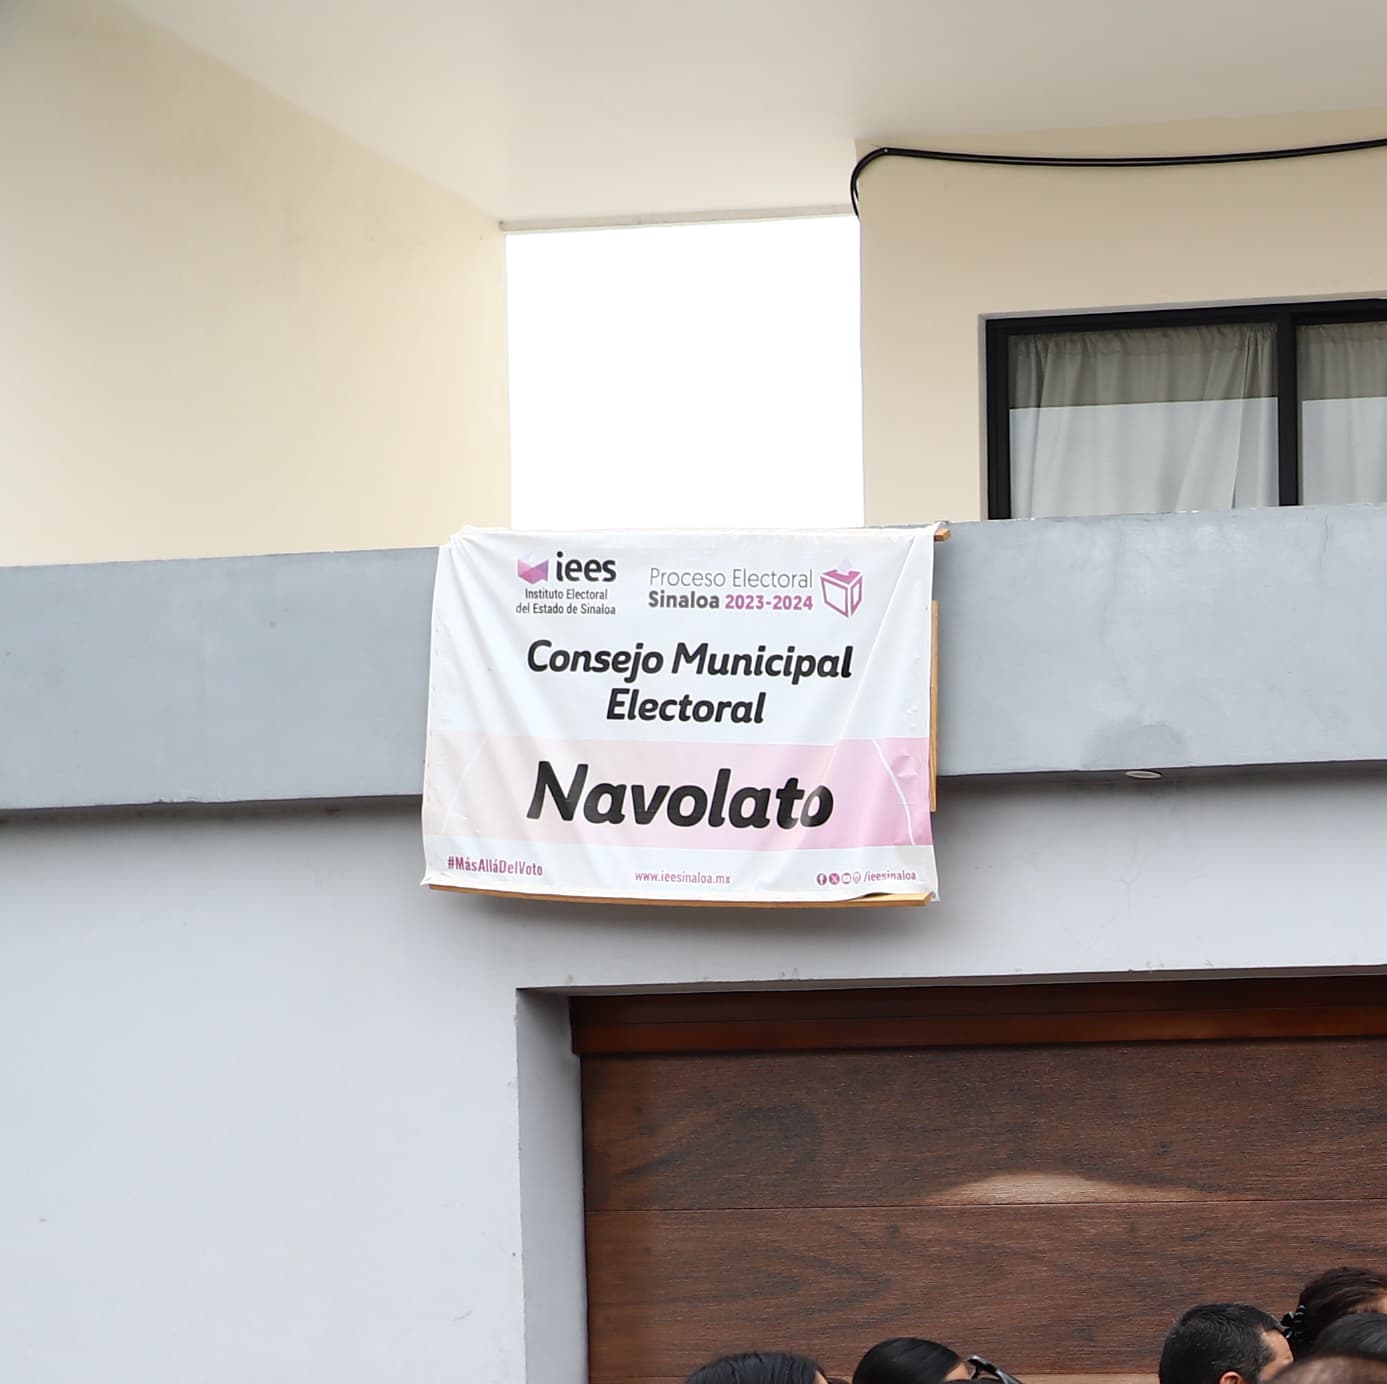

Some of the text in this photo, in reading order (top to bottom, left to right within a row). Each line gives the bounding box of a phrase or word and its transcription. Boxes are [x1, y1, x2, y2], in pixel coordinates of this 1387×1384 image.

[556, 551, 617, 583] iees
[649, 567, 813, 589] Proceso Electoral
[525, 588, 608, 601] Instituto Electoral
[648, 590, 813, 611] Sinaloa 2023-2024
[516, 601, 616, 616] del Estado de Sinaloa
[527, 639, 853, 686] Consejo Municipal
[606, 687, 766, 724] Electoral
[526, 760, 834, 829] Navolato
[447, 854, 543, 878] #MásAlláDelVoto
[862, 869, 917, 884] /ieesinaloa
[634, 870, 731, 886] www.ieesinaloa.mx
